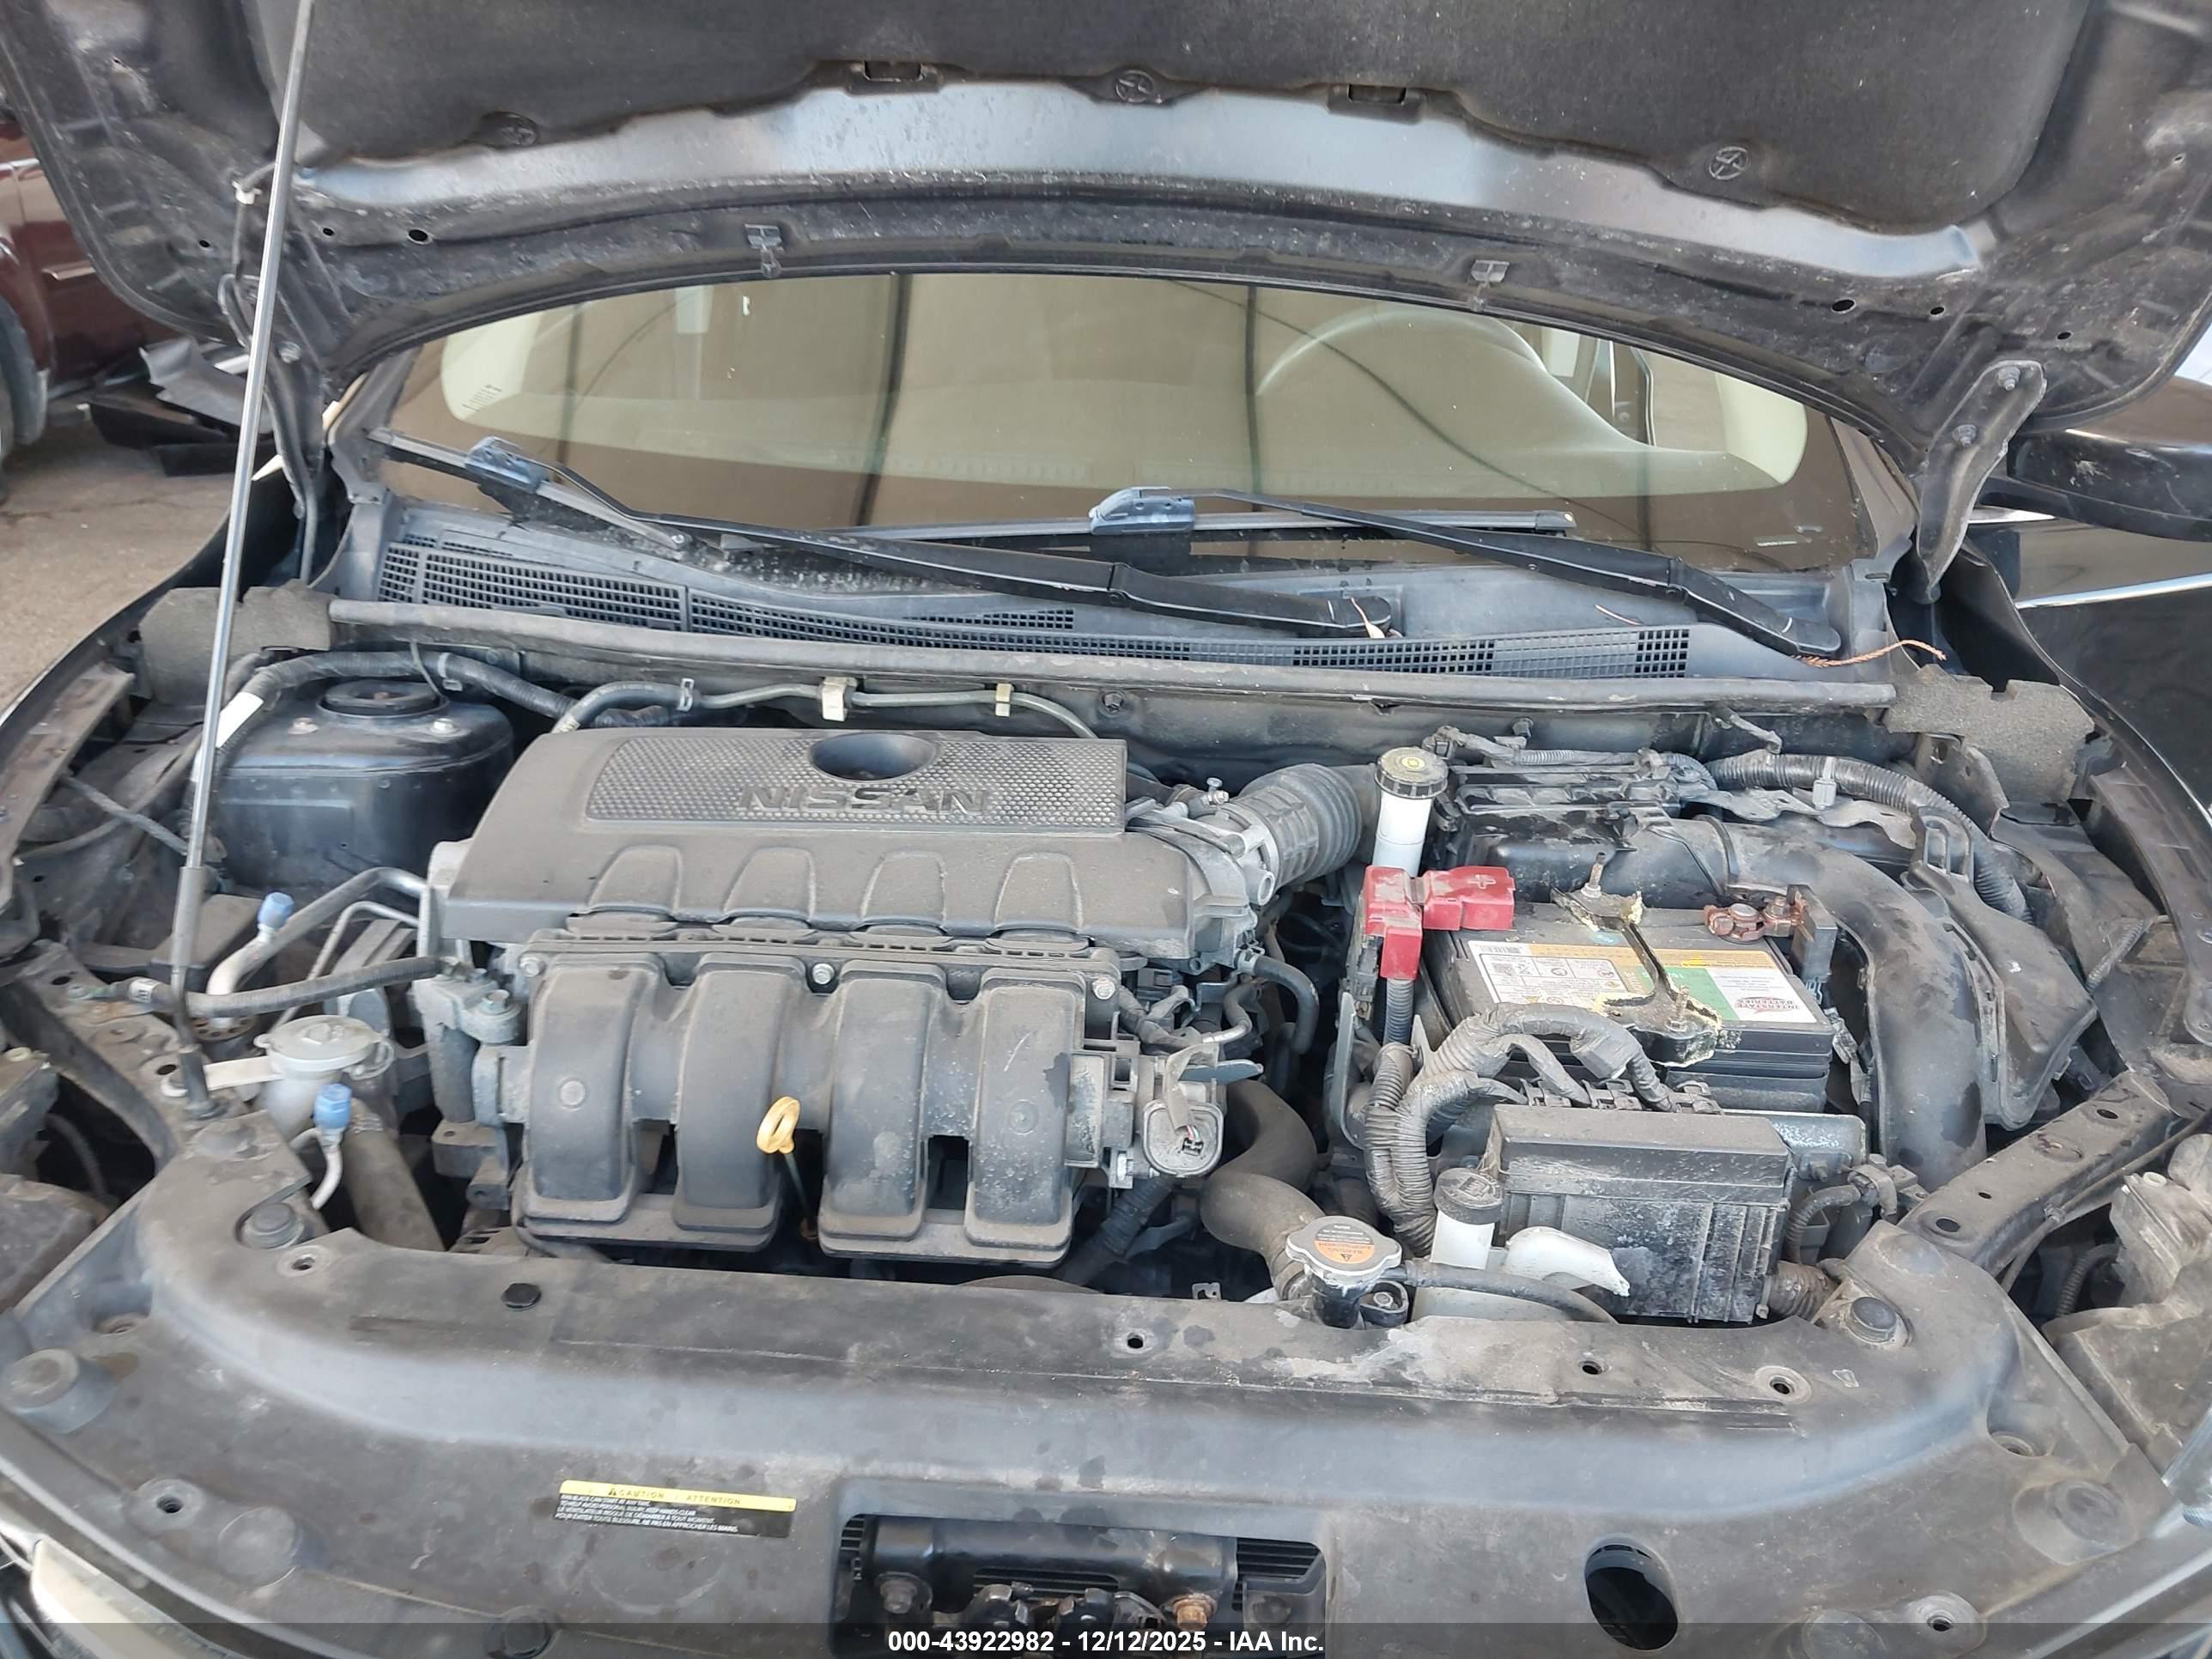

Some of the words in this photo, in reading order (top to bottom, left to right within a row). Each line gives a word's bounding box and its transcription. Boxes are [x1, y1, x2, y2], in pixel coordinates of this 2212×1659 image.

[739, 787, 987, 814] NISSAN
[619, 1490, 665, 1498] CAUTION
[687, 1495, 740, 1504] ATTENTION
